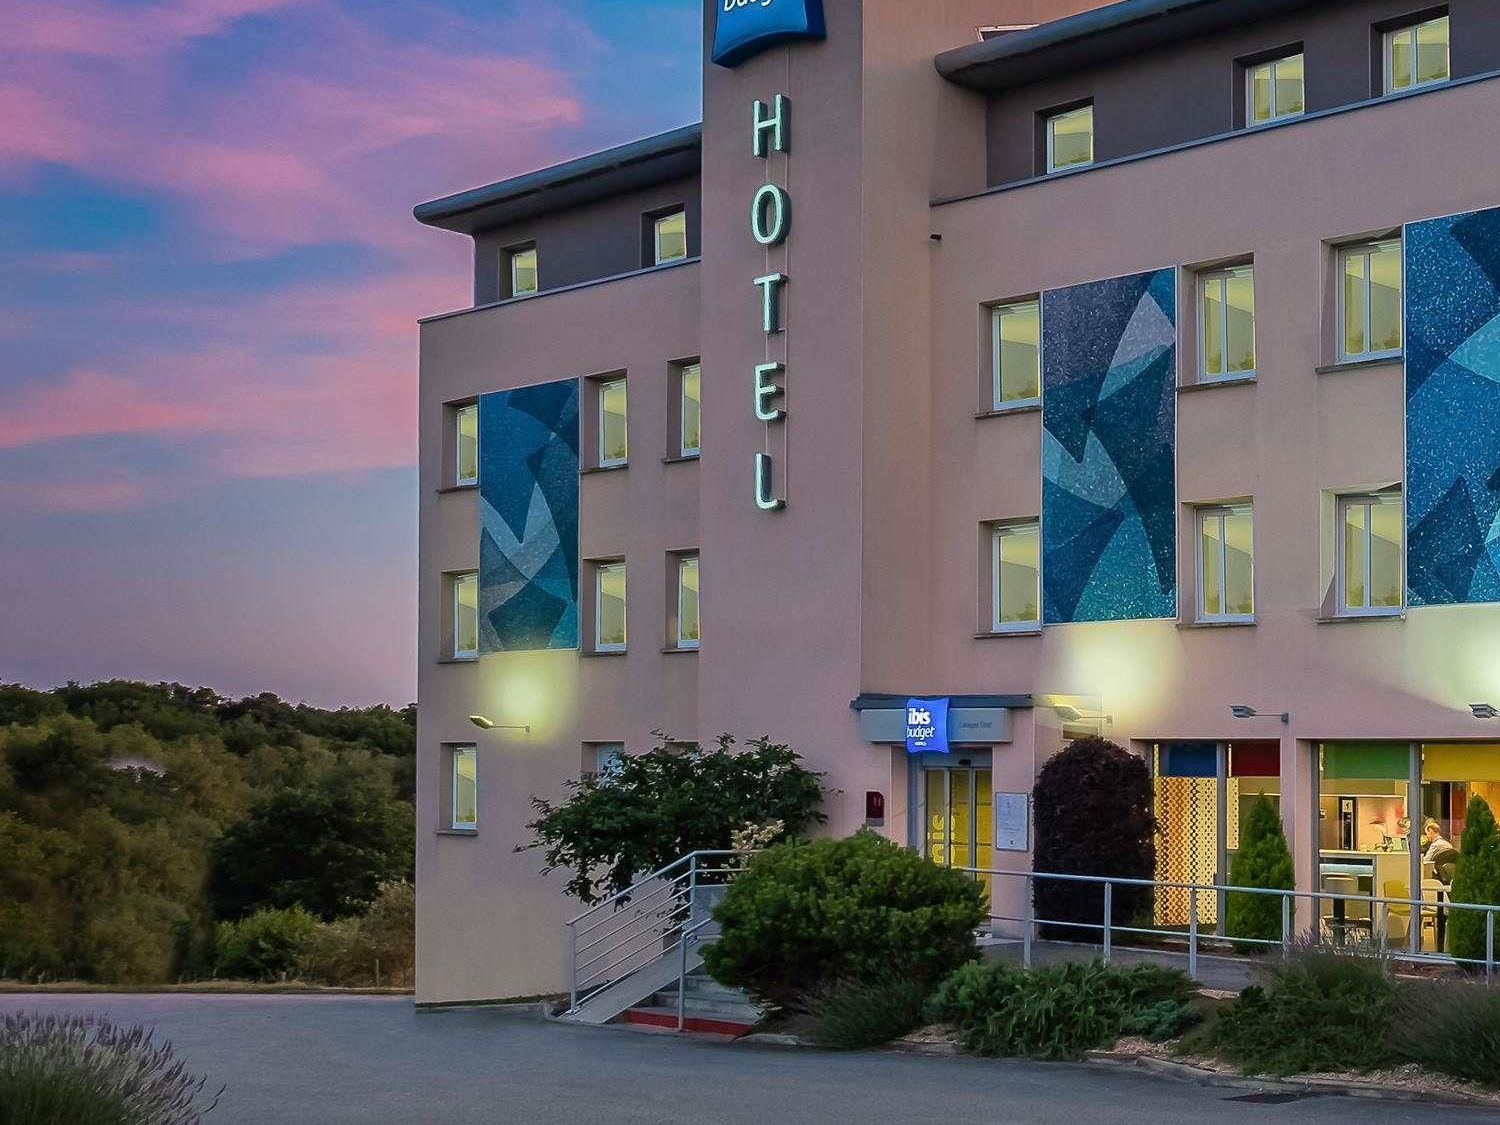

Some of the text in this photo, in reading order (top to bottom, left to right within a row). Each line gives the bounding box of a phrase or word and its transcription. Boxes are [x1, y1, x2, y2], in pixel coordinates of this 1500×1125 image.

[752, 92, 788, 510] HOTEL
[908, 707, 931, 725] ibis
[906, 725, 935, 740] budget
